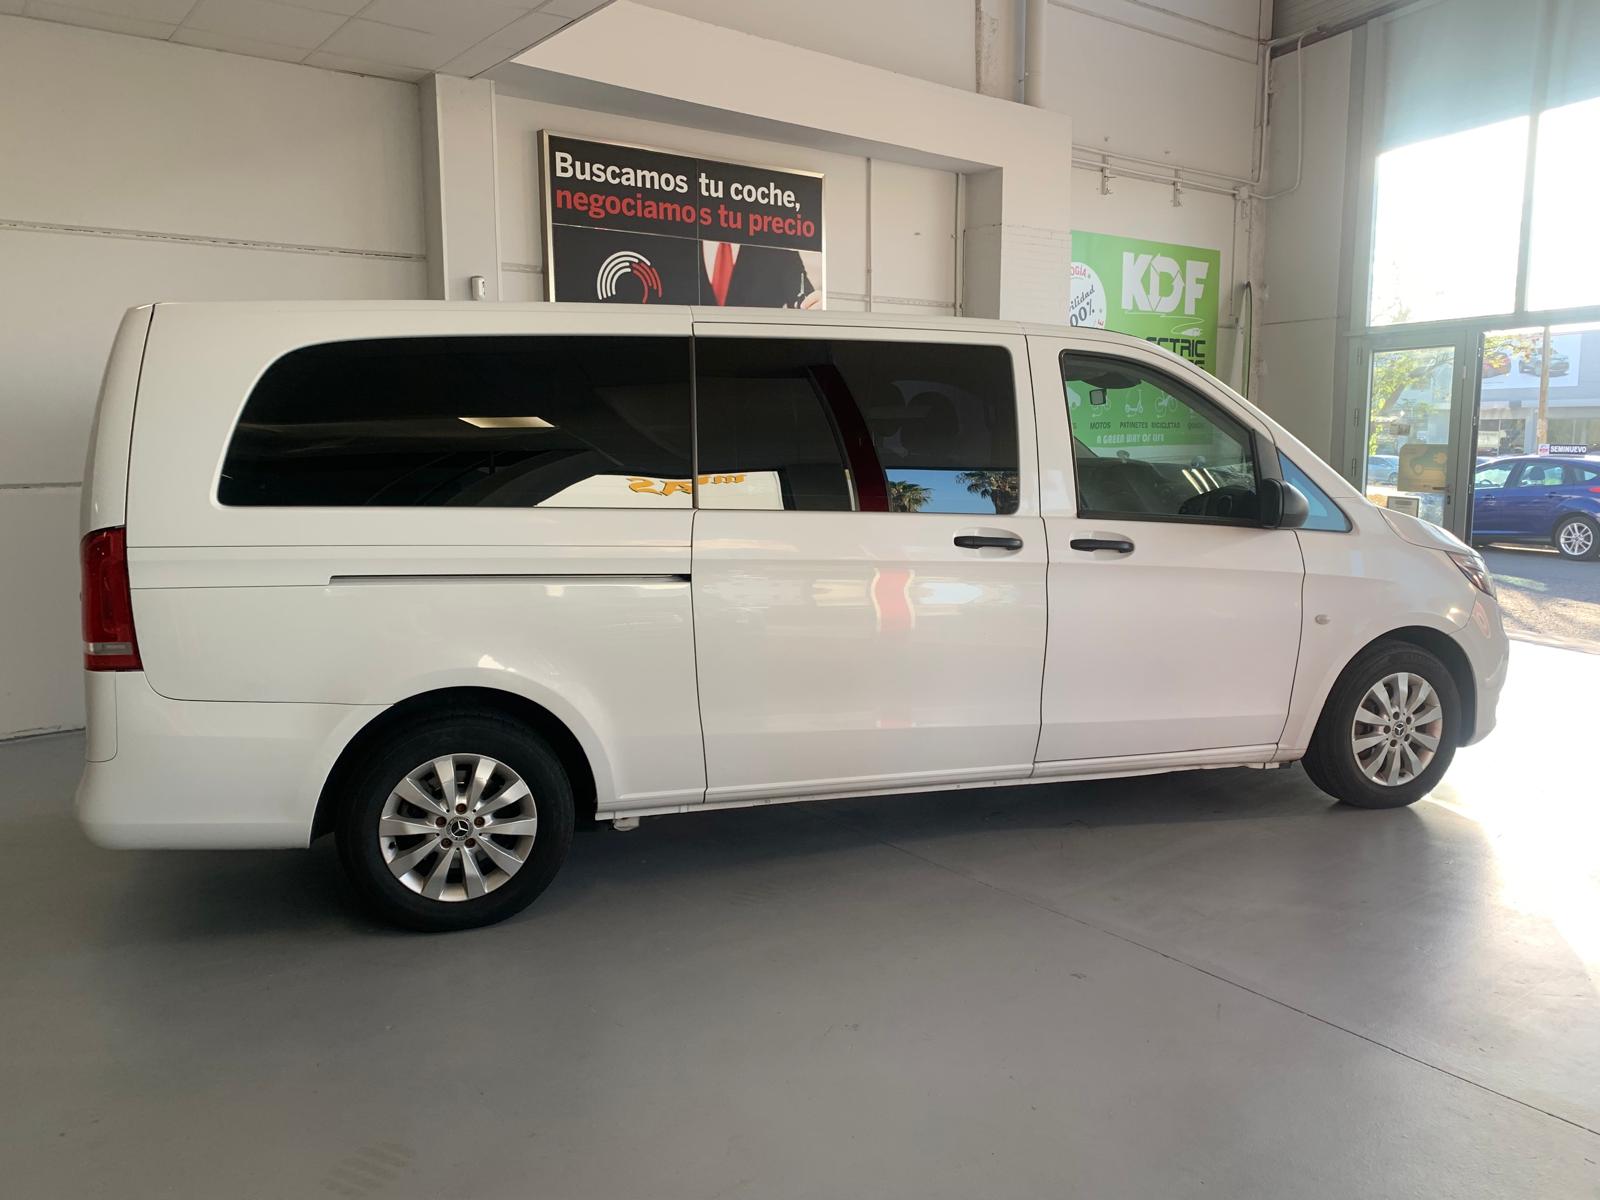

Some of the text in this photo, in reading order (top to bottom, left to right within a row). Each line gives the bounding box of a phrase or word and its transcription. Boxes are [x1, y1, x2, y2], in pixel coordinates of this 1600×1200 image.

[555, 151, 801, 212] Buscamos tu coche,
[556, 189, 815, 238] negociamos tu precio
[1121, 251, 1209, 315] KDF
[1090, 421, 1111, 430] MOTOS
[1550, 445, 1587, 453] SEMINUEVO
